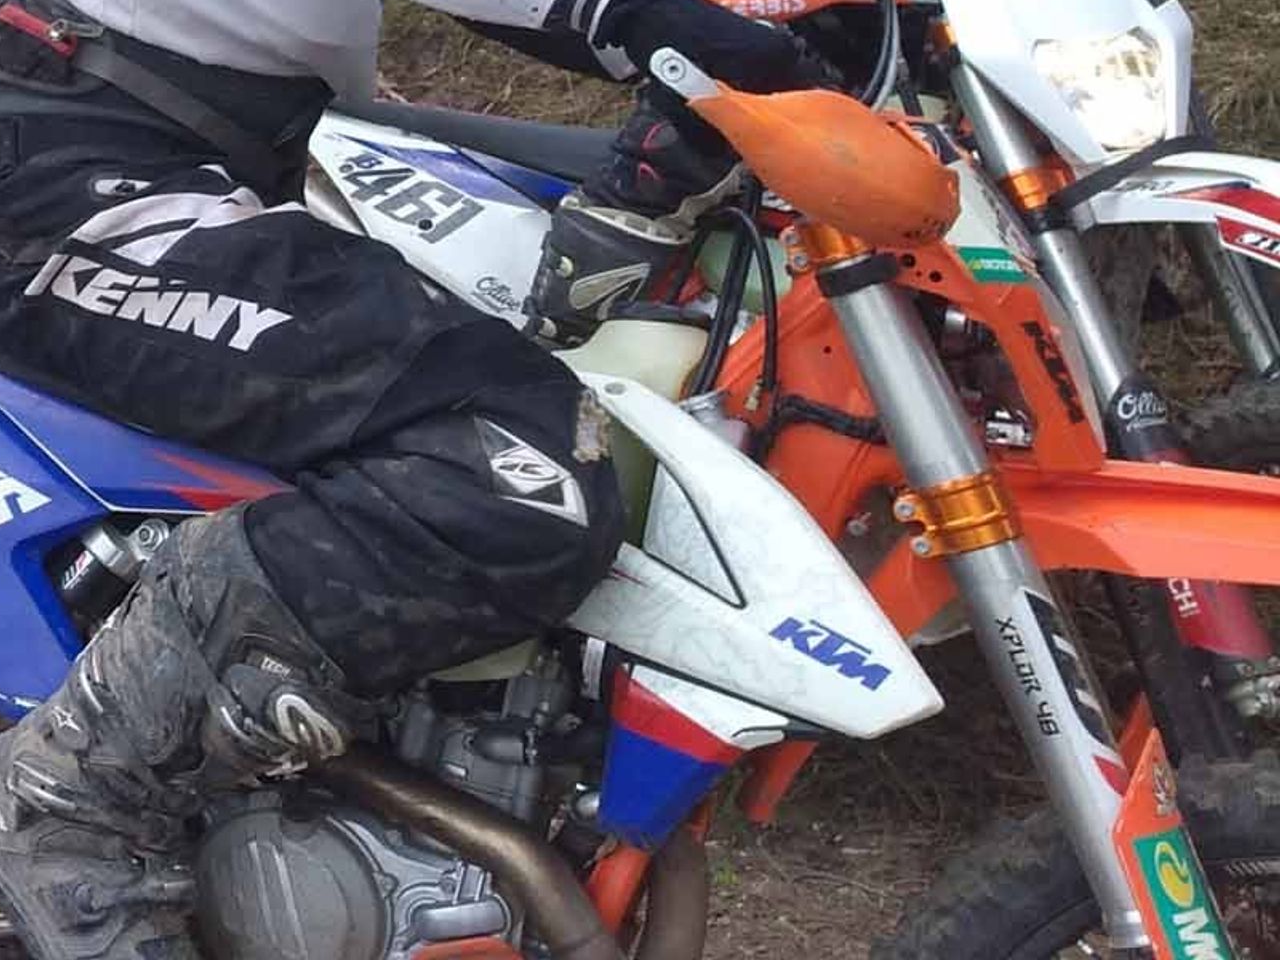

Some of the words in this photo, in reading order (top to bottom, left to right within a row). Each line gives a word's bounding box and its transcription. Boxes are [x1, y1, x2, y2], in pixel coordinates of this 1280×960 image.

[340, 166, 486, 245] 461
[24, 253, 295, 352] KENNY
[768, 616, 893, 692] KTM
[995, 616, 1042, 695] XPLOR
[1036, 700, 1061, 736] 48
